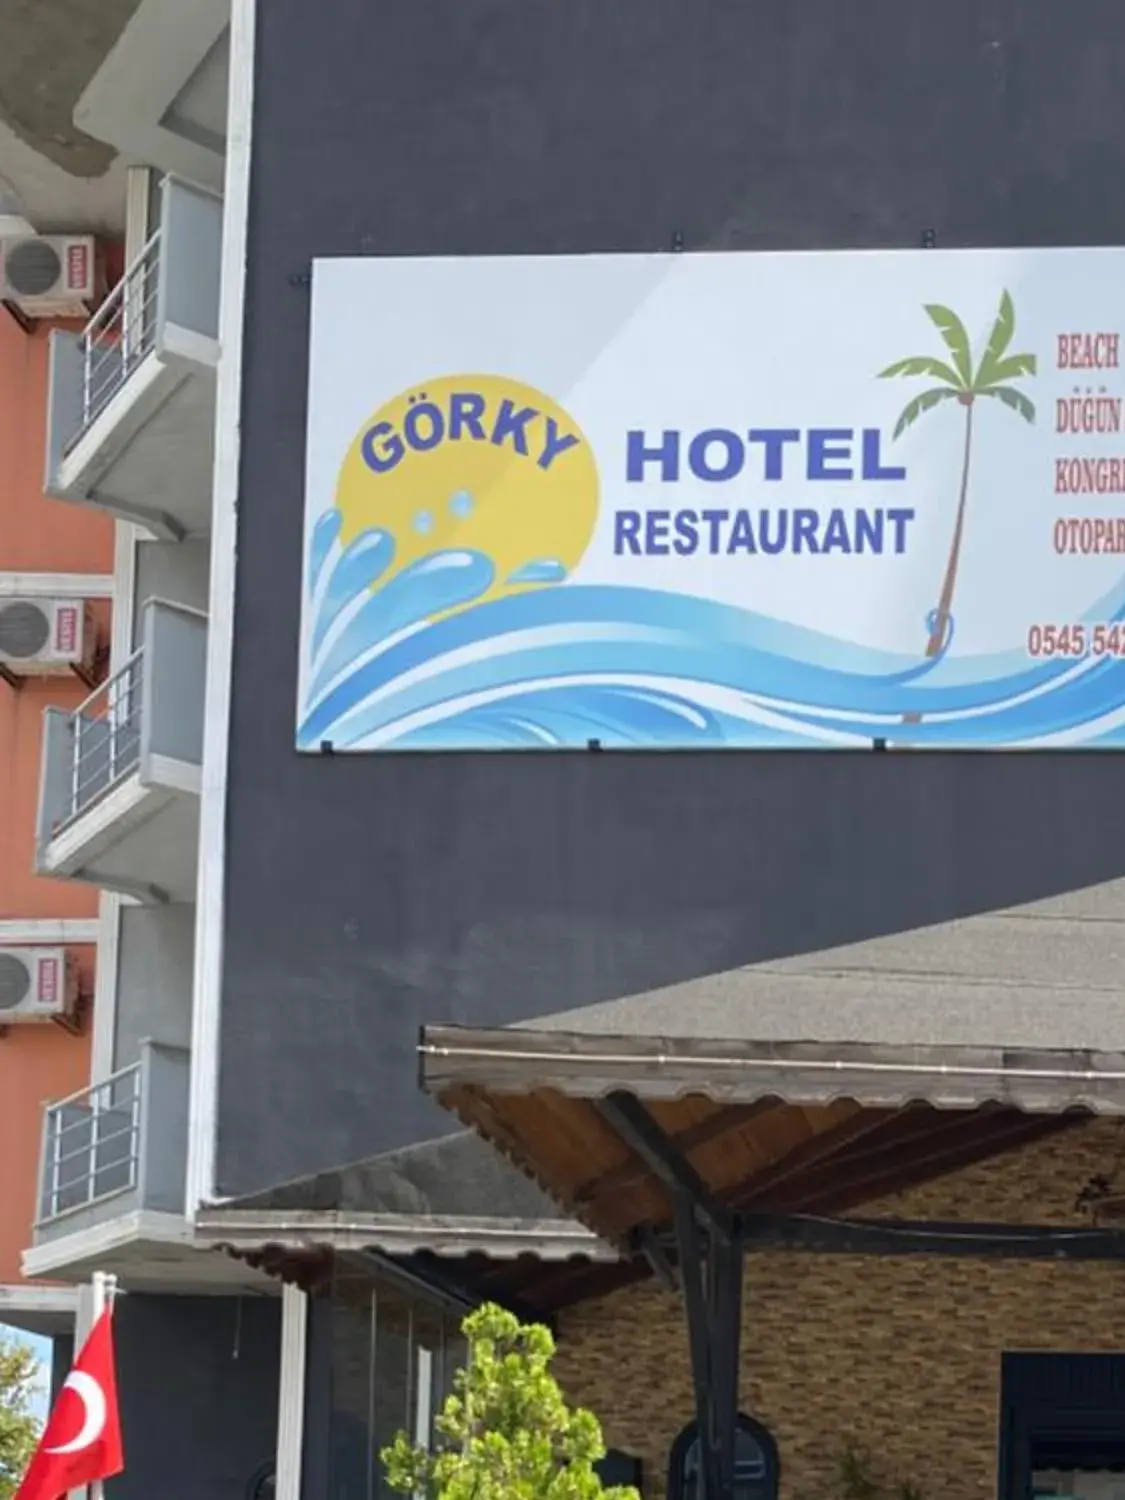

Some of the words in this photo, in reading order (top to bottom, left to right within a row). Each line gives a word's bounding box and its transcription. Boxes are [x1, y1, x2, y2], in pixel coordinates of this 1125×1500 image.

[1057, 333, 1120, 369] BEACH
[361, 394, 580, 473] GÖRKY
[1056, 385, 1121, 434] DÜĞÜN
[625, 429, 906, 482] HOTEL
[613, 508, 915, 556] RESTAURANT
[1028, 624, 1084, 657] 0545
